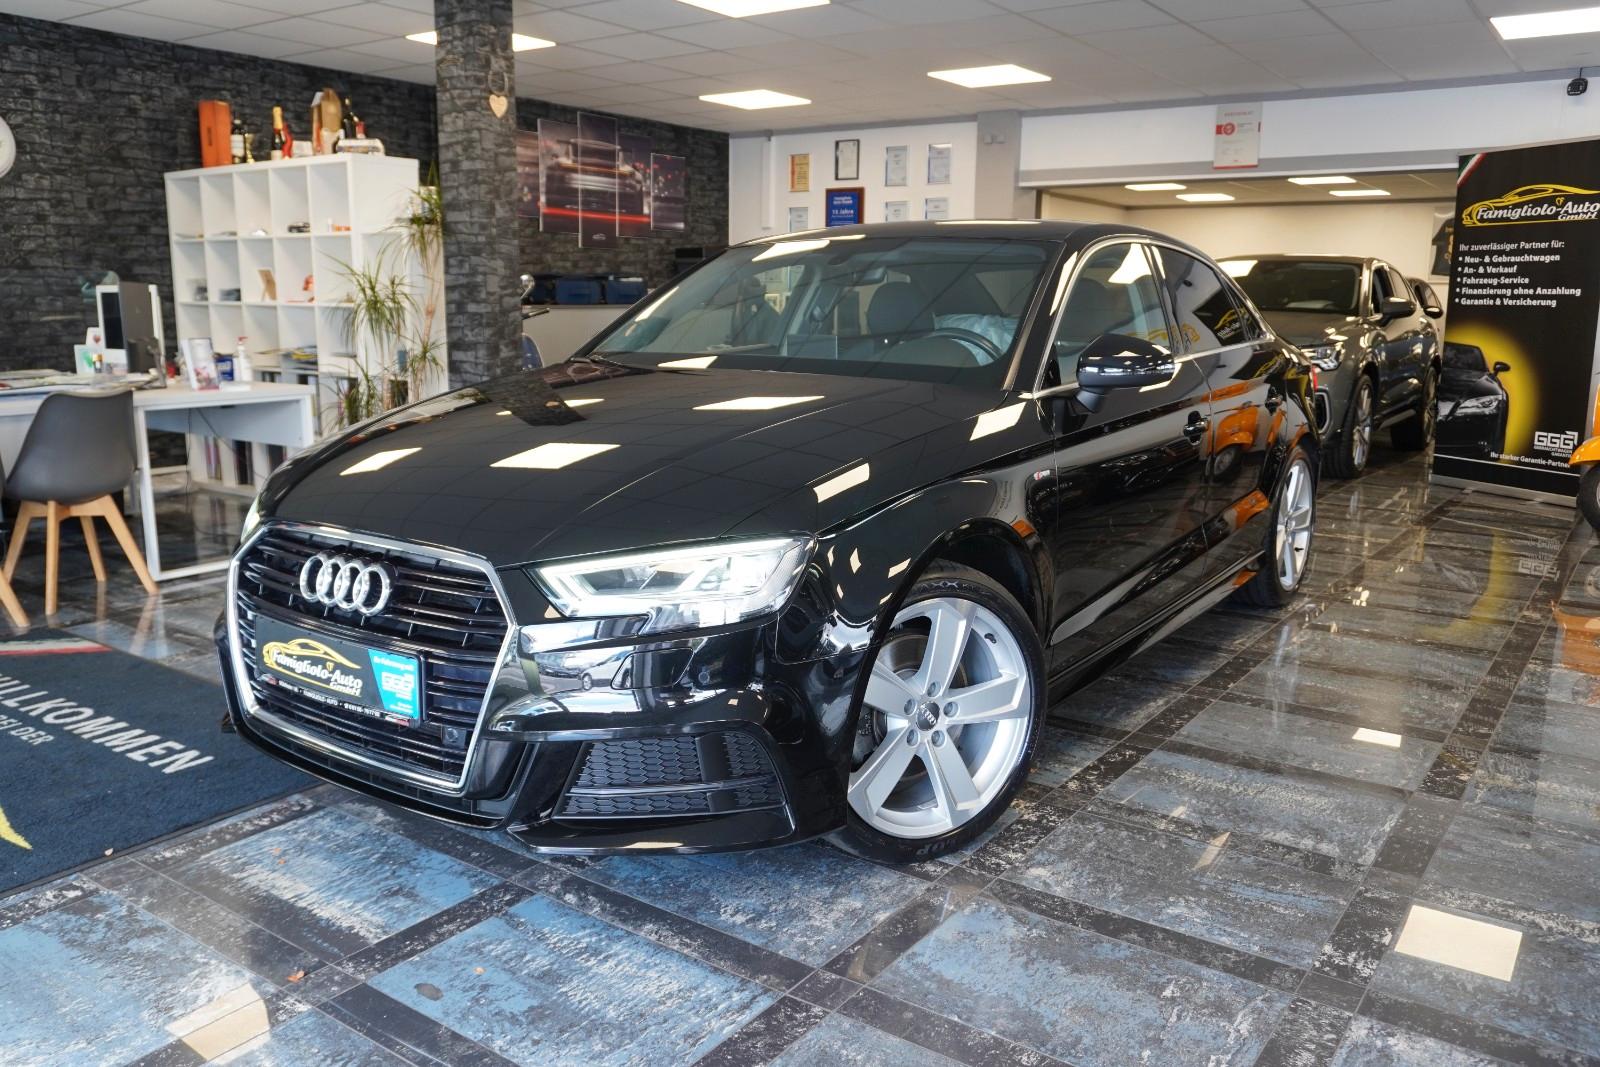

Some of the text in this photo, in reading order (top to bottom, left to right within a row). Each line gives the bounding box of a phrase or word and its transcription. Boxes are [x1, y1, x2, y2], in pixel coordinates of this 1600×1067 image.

[1477, 201, 1600, 220] Famigliolo-Auto
[1558, 212, 1598, 220] GmbH
[1470, 243, 1518, 252] zuverlässiger
[1551, 240, 1564, 248] für:
[1464, 255, 1482, 263] Neu-
[1492, 254, 1560, 263] Gebrauchtwagen
[1463, 265, 1518, 274] An- & Verkauf
[1462, 276, 1530, 285] Fahrzeug-Service
[1462, 287, 1582, 296] Finanzierung ohne Anzahlung
[1502, 298, 1557, 307] Versicherung
[1534, 431, 1577, 450] GGG
[1500, 452, 1520, 461] starker
[273, 650, 363, 690] Famigliolo-Auto
[8, 726, 55, 746] DER
